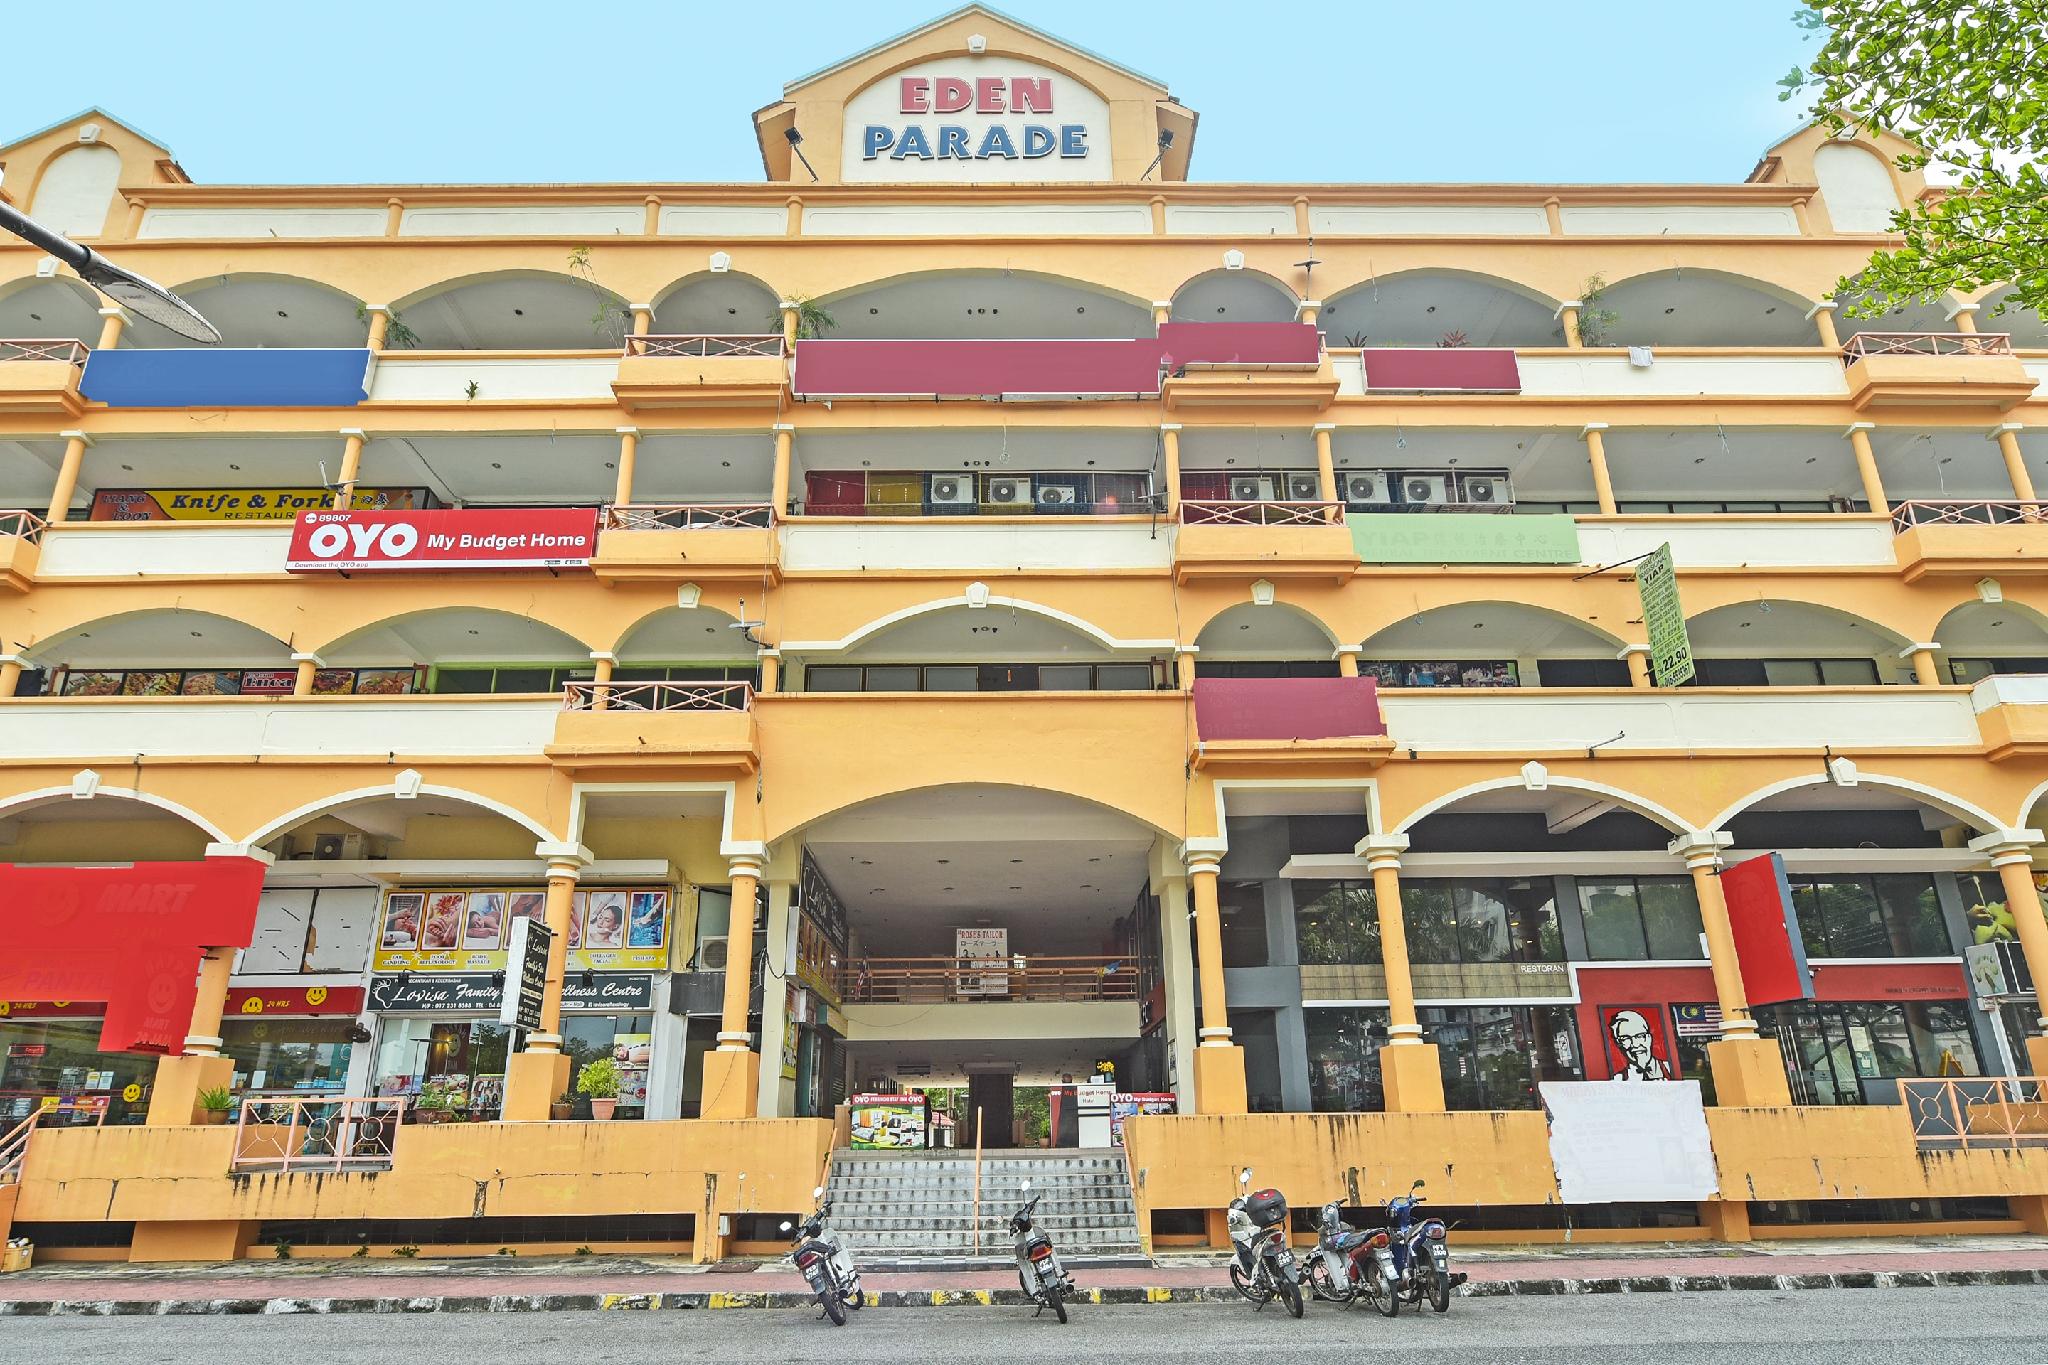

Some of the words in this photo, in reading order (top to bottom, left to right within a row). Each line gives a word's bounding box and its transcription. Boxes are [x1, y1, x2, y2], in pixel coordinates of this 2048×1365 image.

[900, 75, 1054, 114] EDEN
[863, 123, 1089, 160] PARADE
[170, 494, 240, 513] Knife
[246, 494, 267, 509] &
[274, 493, 335, 509] Fork
[319, 514, 352, 522] 89807
[309, 523, 418, 558] OYO
[427, 534, 455, 550] My
[459, 533, 526, 550] Budget
[530, 533, 586, 547] Home
[1643, 563, 1664, 585] YIAP
[1662, 646, 1688, 672] 22.90
[983, 931, 1003, 939] TAILOR
[1521, 965, 1564, 973] RESTORAN
[390, 986, 450, 1002] Lovisa
[456, 984, 500, 1000] Family
[602, 982, 642, 996] Centre
[266, 1000, 276, 1008] 24
[1110, 1093, 1133, 1103] OYO
